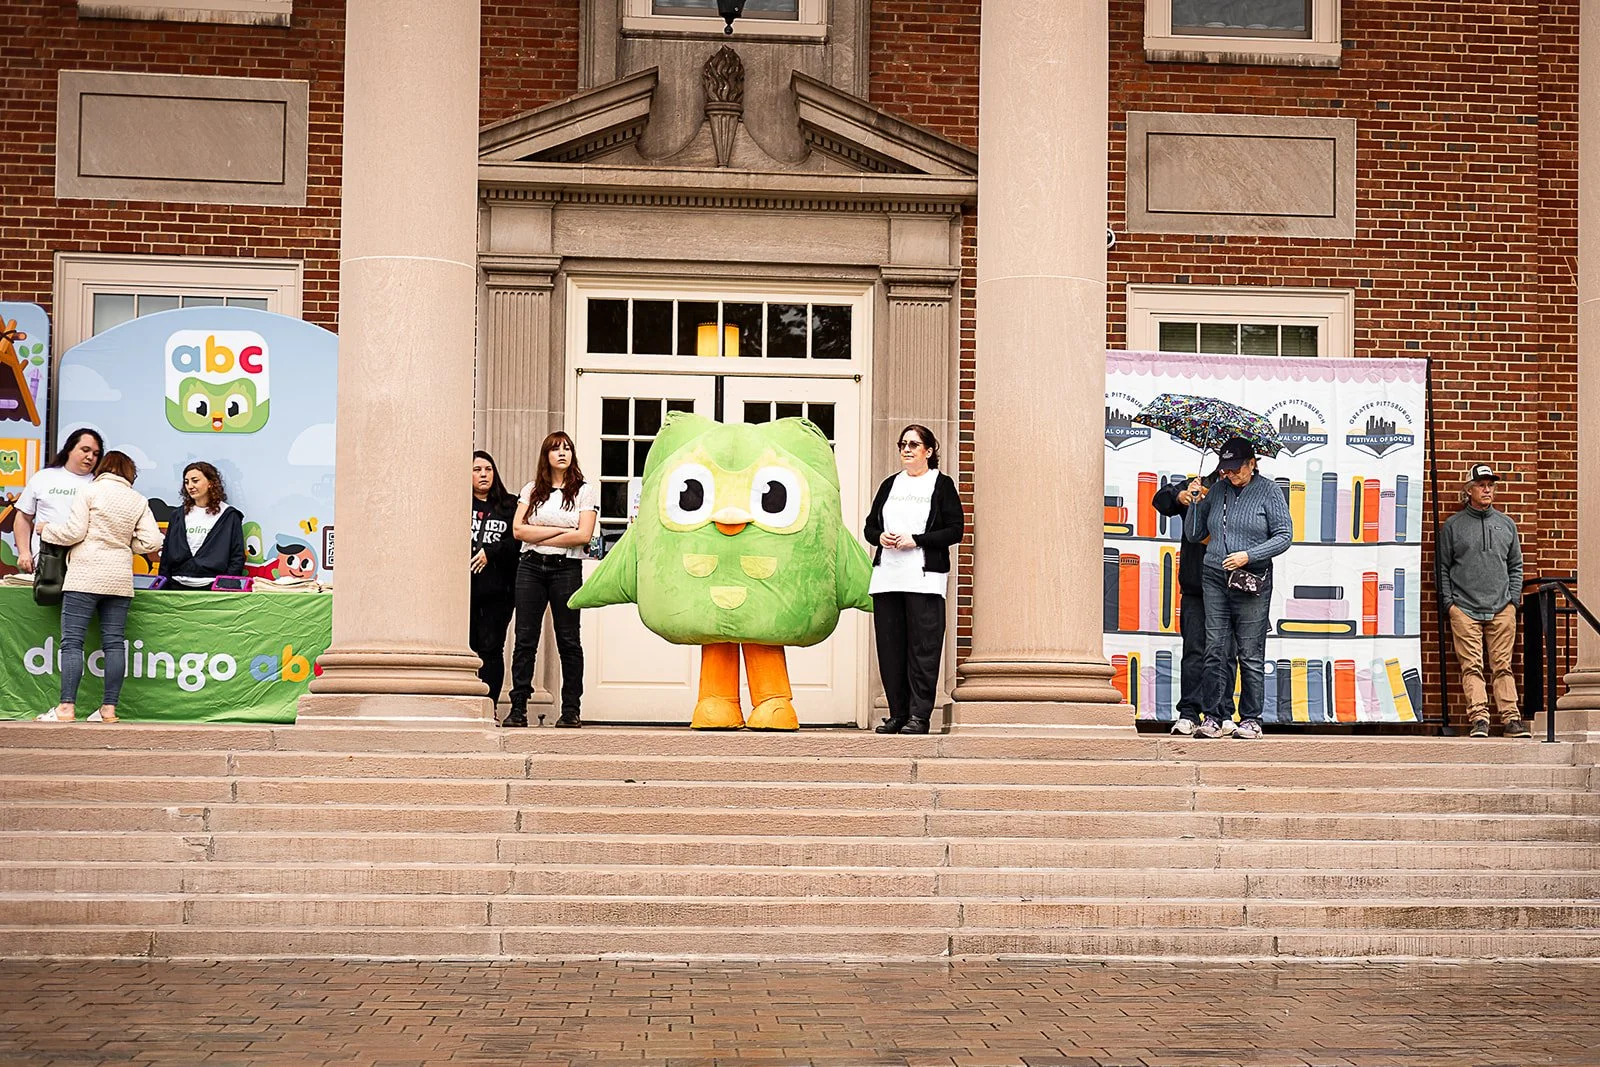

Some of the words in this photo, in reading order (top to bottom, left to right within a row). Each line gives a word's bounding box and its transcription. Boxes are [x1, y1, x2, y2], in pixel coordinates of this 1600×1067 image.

[171, 335, 263, 374] abc
[1264, 400, 1287, 418] REATER
[1288, 399, 1327, 425] PITTSBURGH
[1349, 402, 1375, 425] GREATER
[1376, 400, 1413, 425] PITTSBURGH
[1389, 435, 1412, 443] BOOKS
[48, 487, 77, 496] duoli
[250, 644, 324, 683] ab
